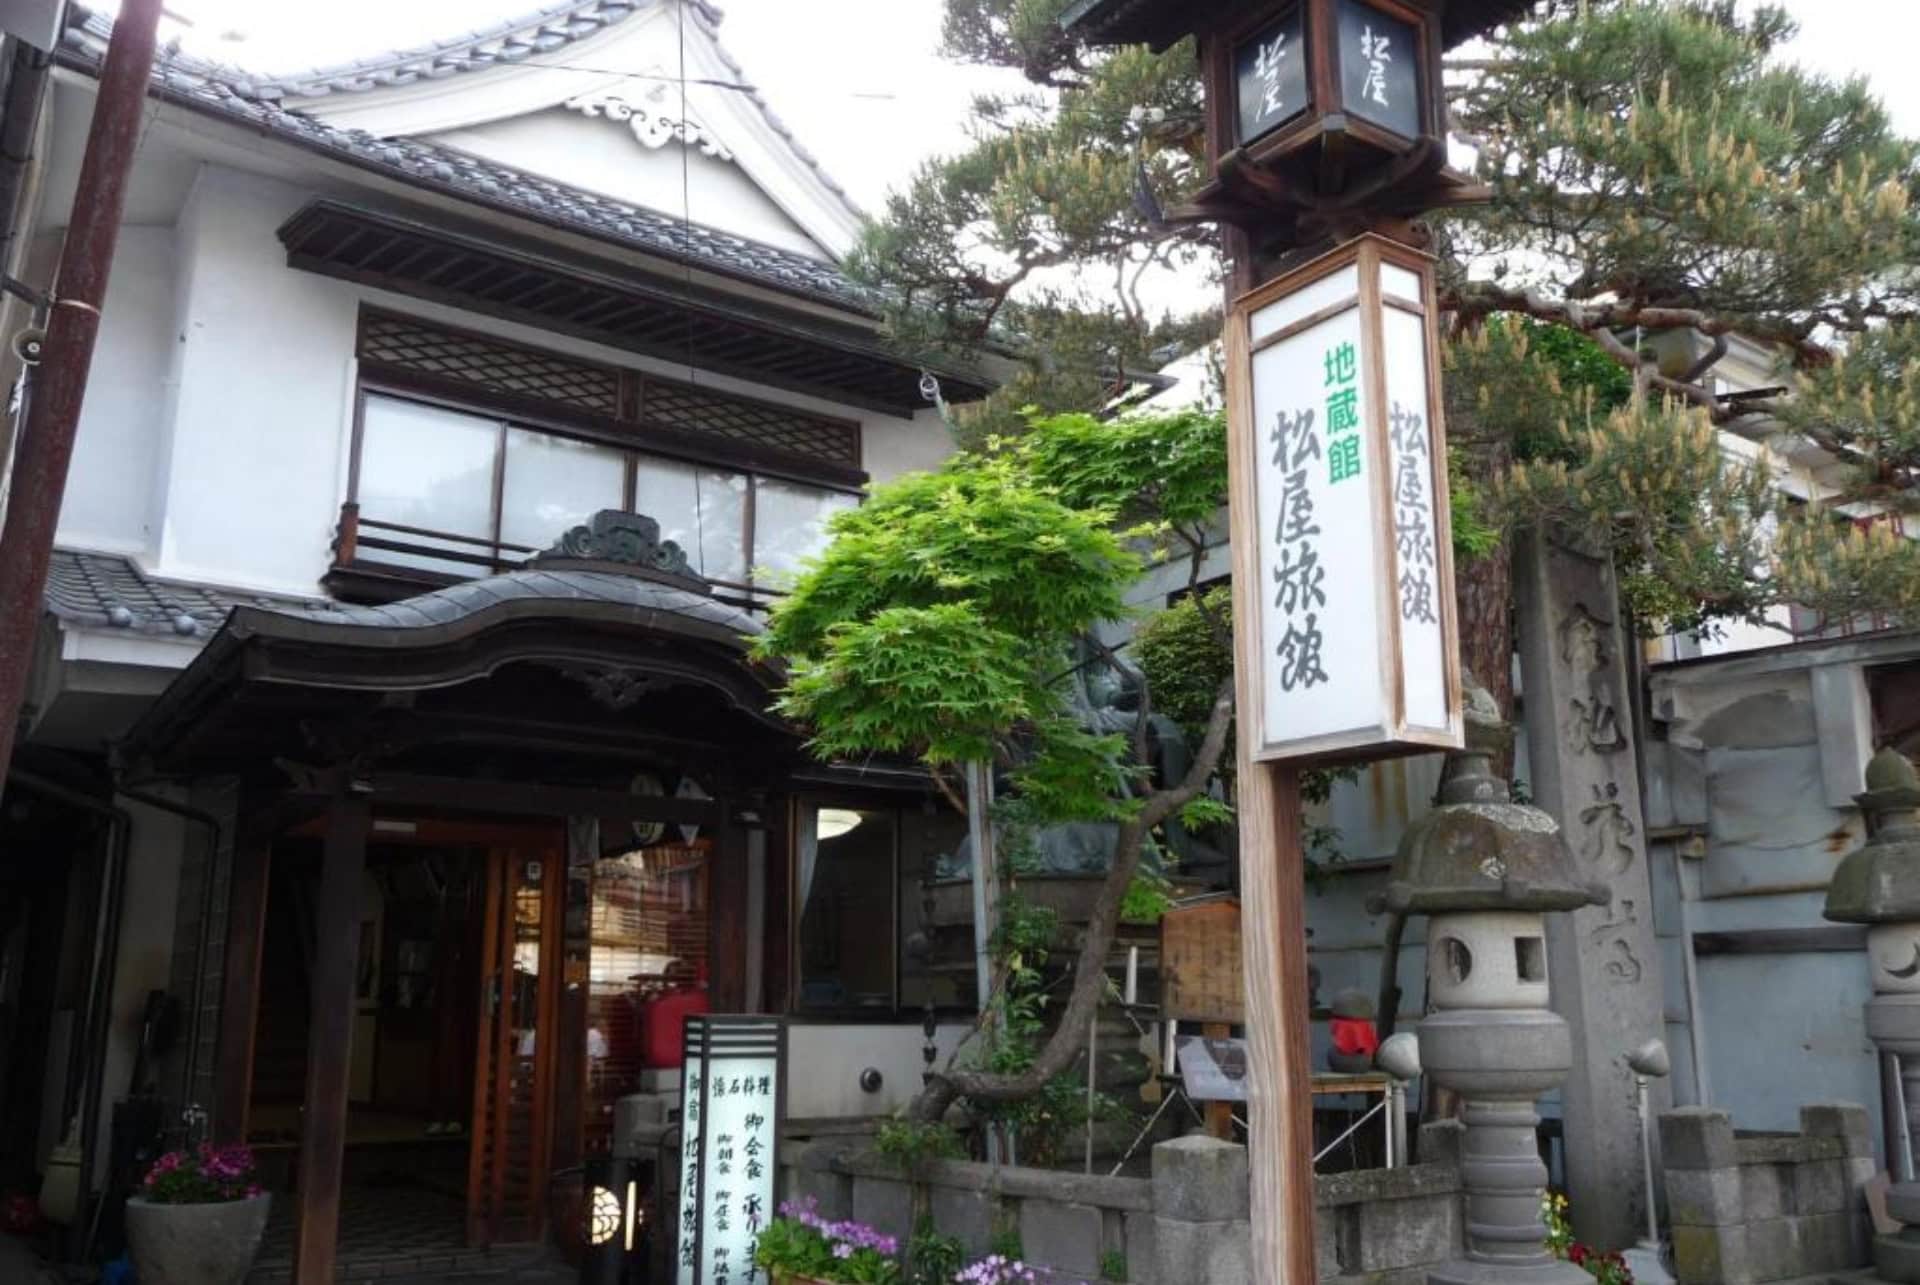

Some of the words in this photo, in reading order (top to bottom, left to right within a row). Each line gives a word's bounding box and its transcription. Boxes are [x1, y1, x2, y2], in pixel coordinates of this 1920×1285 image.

[1253, 32, 1286, 123] 松屋
[1360, 25, 1391, 107] 松屋
[1323, 341, 1362, 486] 地蔵館
[1269, 407, 1330, 694] 松屋旅館
[1388, 400, 1438, 626] 松屋旅館
